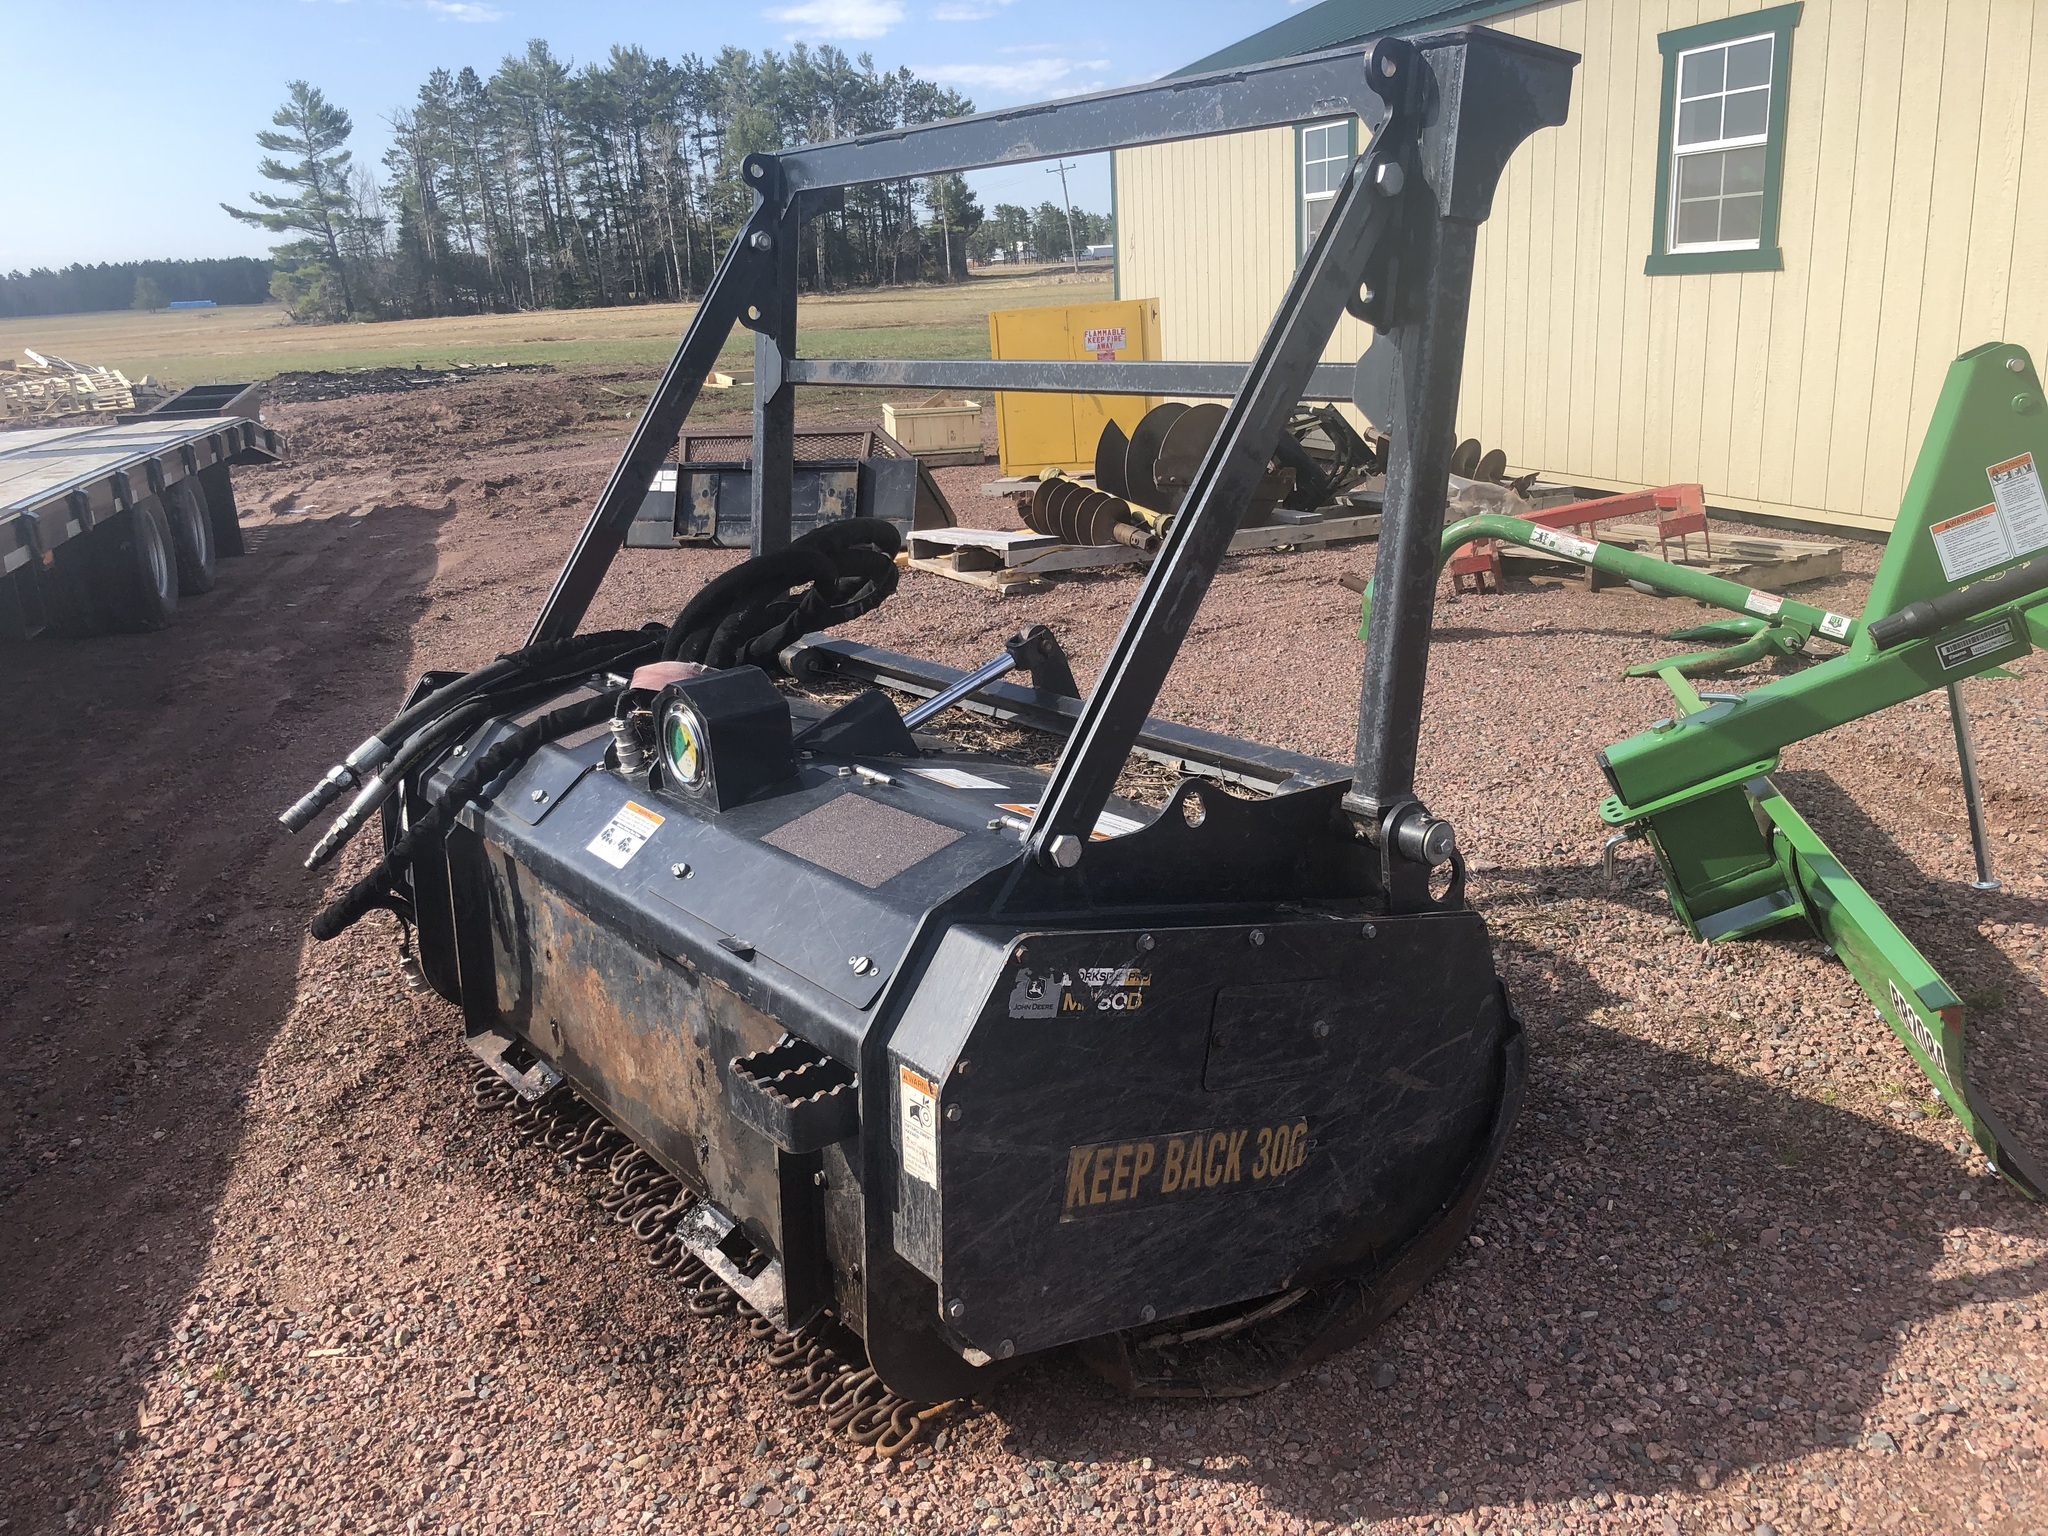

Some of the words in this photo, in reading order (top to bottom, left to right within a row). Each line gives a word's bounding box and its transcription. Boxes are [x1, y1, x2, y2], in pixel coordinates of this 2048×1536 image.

[1084, 328, 1125, 338] FLAMMABLE
[1088, 336, 1105, 344] KEEP
[1998, 456, 2029, 471] WARNING
[1950, 510, 1984, 526] WARNING
[1013, 1003, 1031, 1011] JOHN
[1032, 1003, 1054, 1011] DEERE
[1066, 1143, 1155, 1208] KEEP
[1161, 1129, 1248, 1193] BACK
